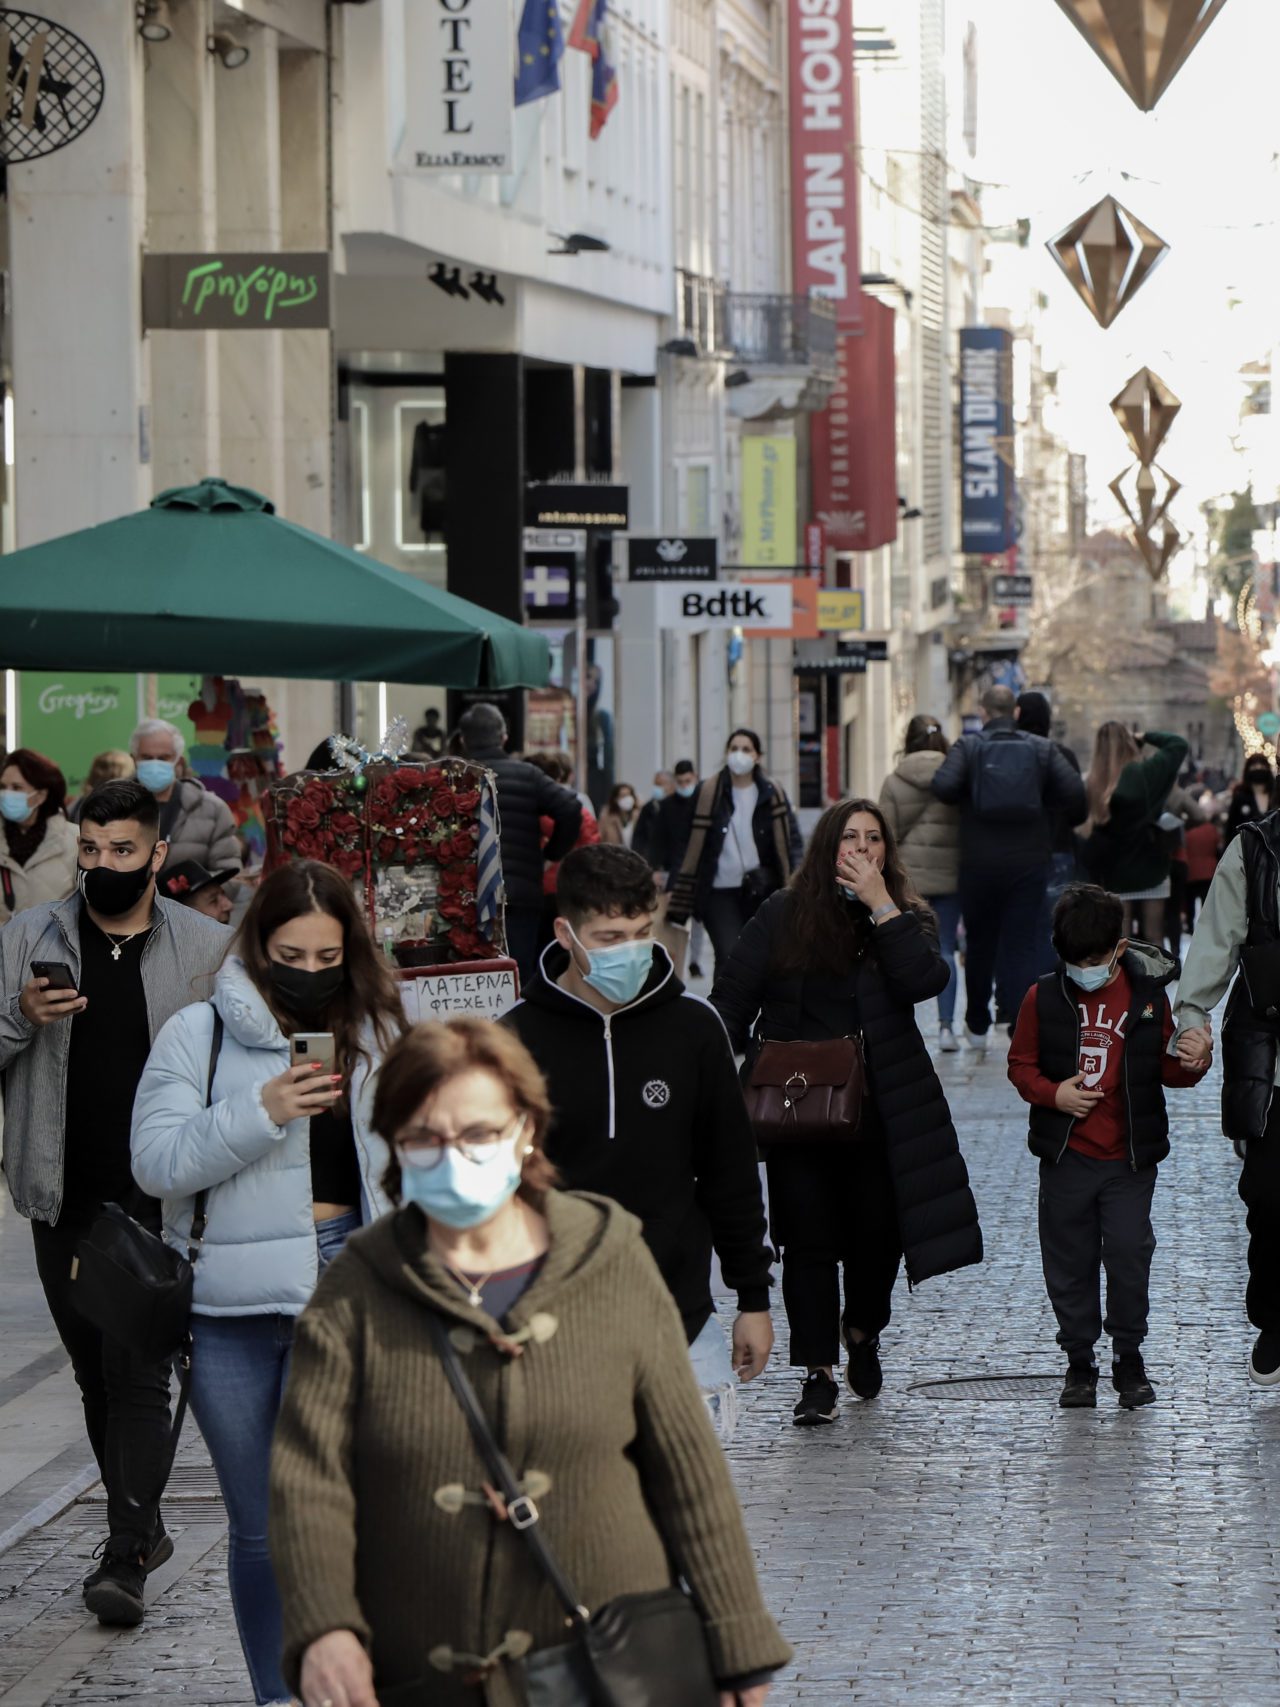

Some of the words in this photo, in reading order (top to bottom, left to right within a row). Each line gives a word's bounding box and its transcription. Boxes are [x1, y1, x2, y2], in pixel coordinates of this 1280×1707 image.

[804, 154, 847, 299] LAPIN
[182, 261, 318, 320] Γρηγόρης
[963, 347, 998, 424] DUNK
[963, 426, 998, 499] SLAM
[682, 590, 765, 617] Bdtk
[421, 972, 512, 996] ΛΑΤΕΡΝΑ
